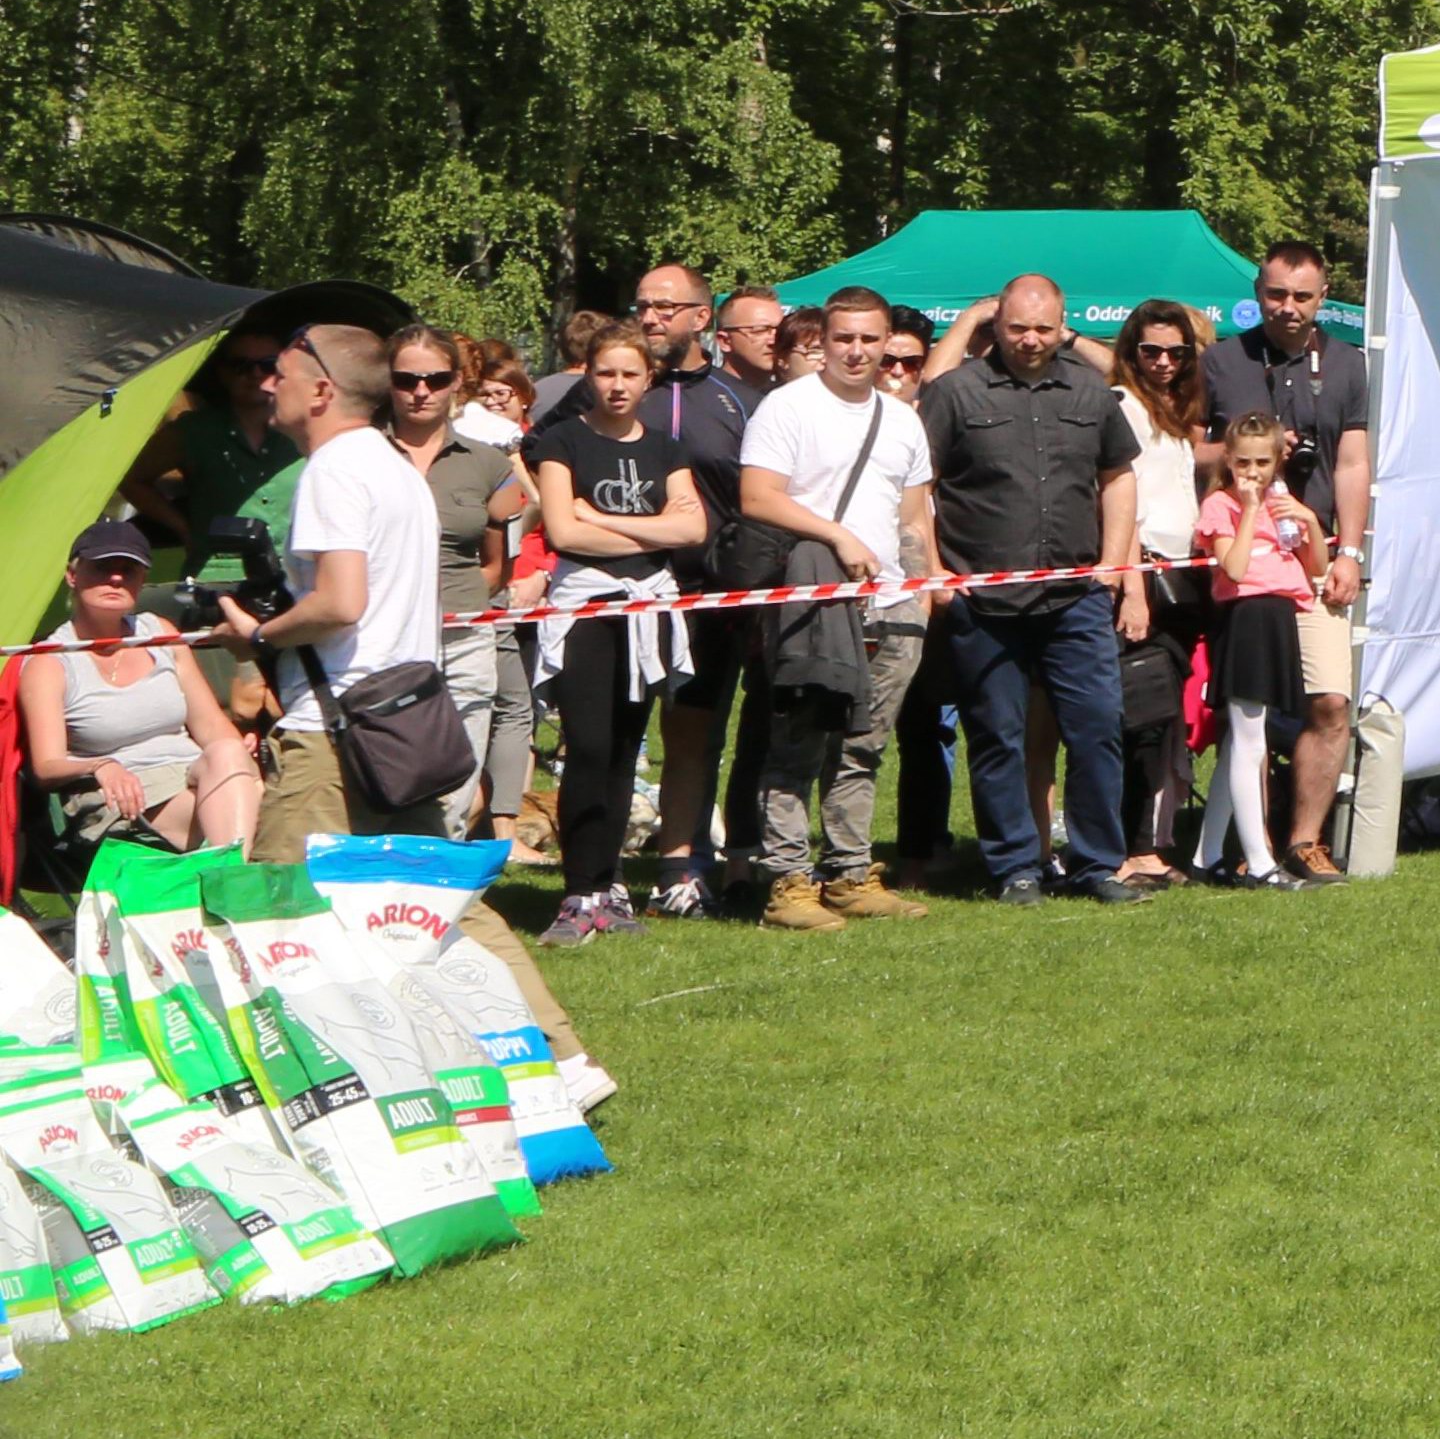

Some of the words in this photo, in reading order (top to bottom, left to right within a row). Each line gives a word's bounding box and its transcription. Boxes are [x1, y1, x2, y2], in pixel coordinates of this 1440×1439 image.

[366, 902, 449, 941] ARION
[161, 999, 197, 1056] ADULT
[251, 1006, 287, 1061] ADULT
[85, 1085, 127, 1102] RION
[440, 1074, 486, 1104] ADULT
[387, 1097, 438, 1130] ADULT
[38, 1124, 79, 1154] ARION
[177, 1124, 222, 1150] ARION
